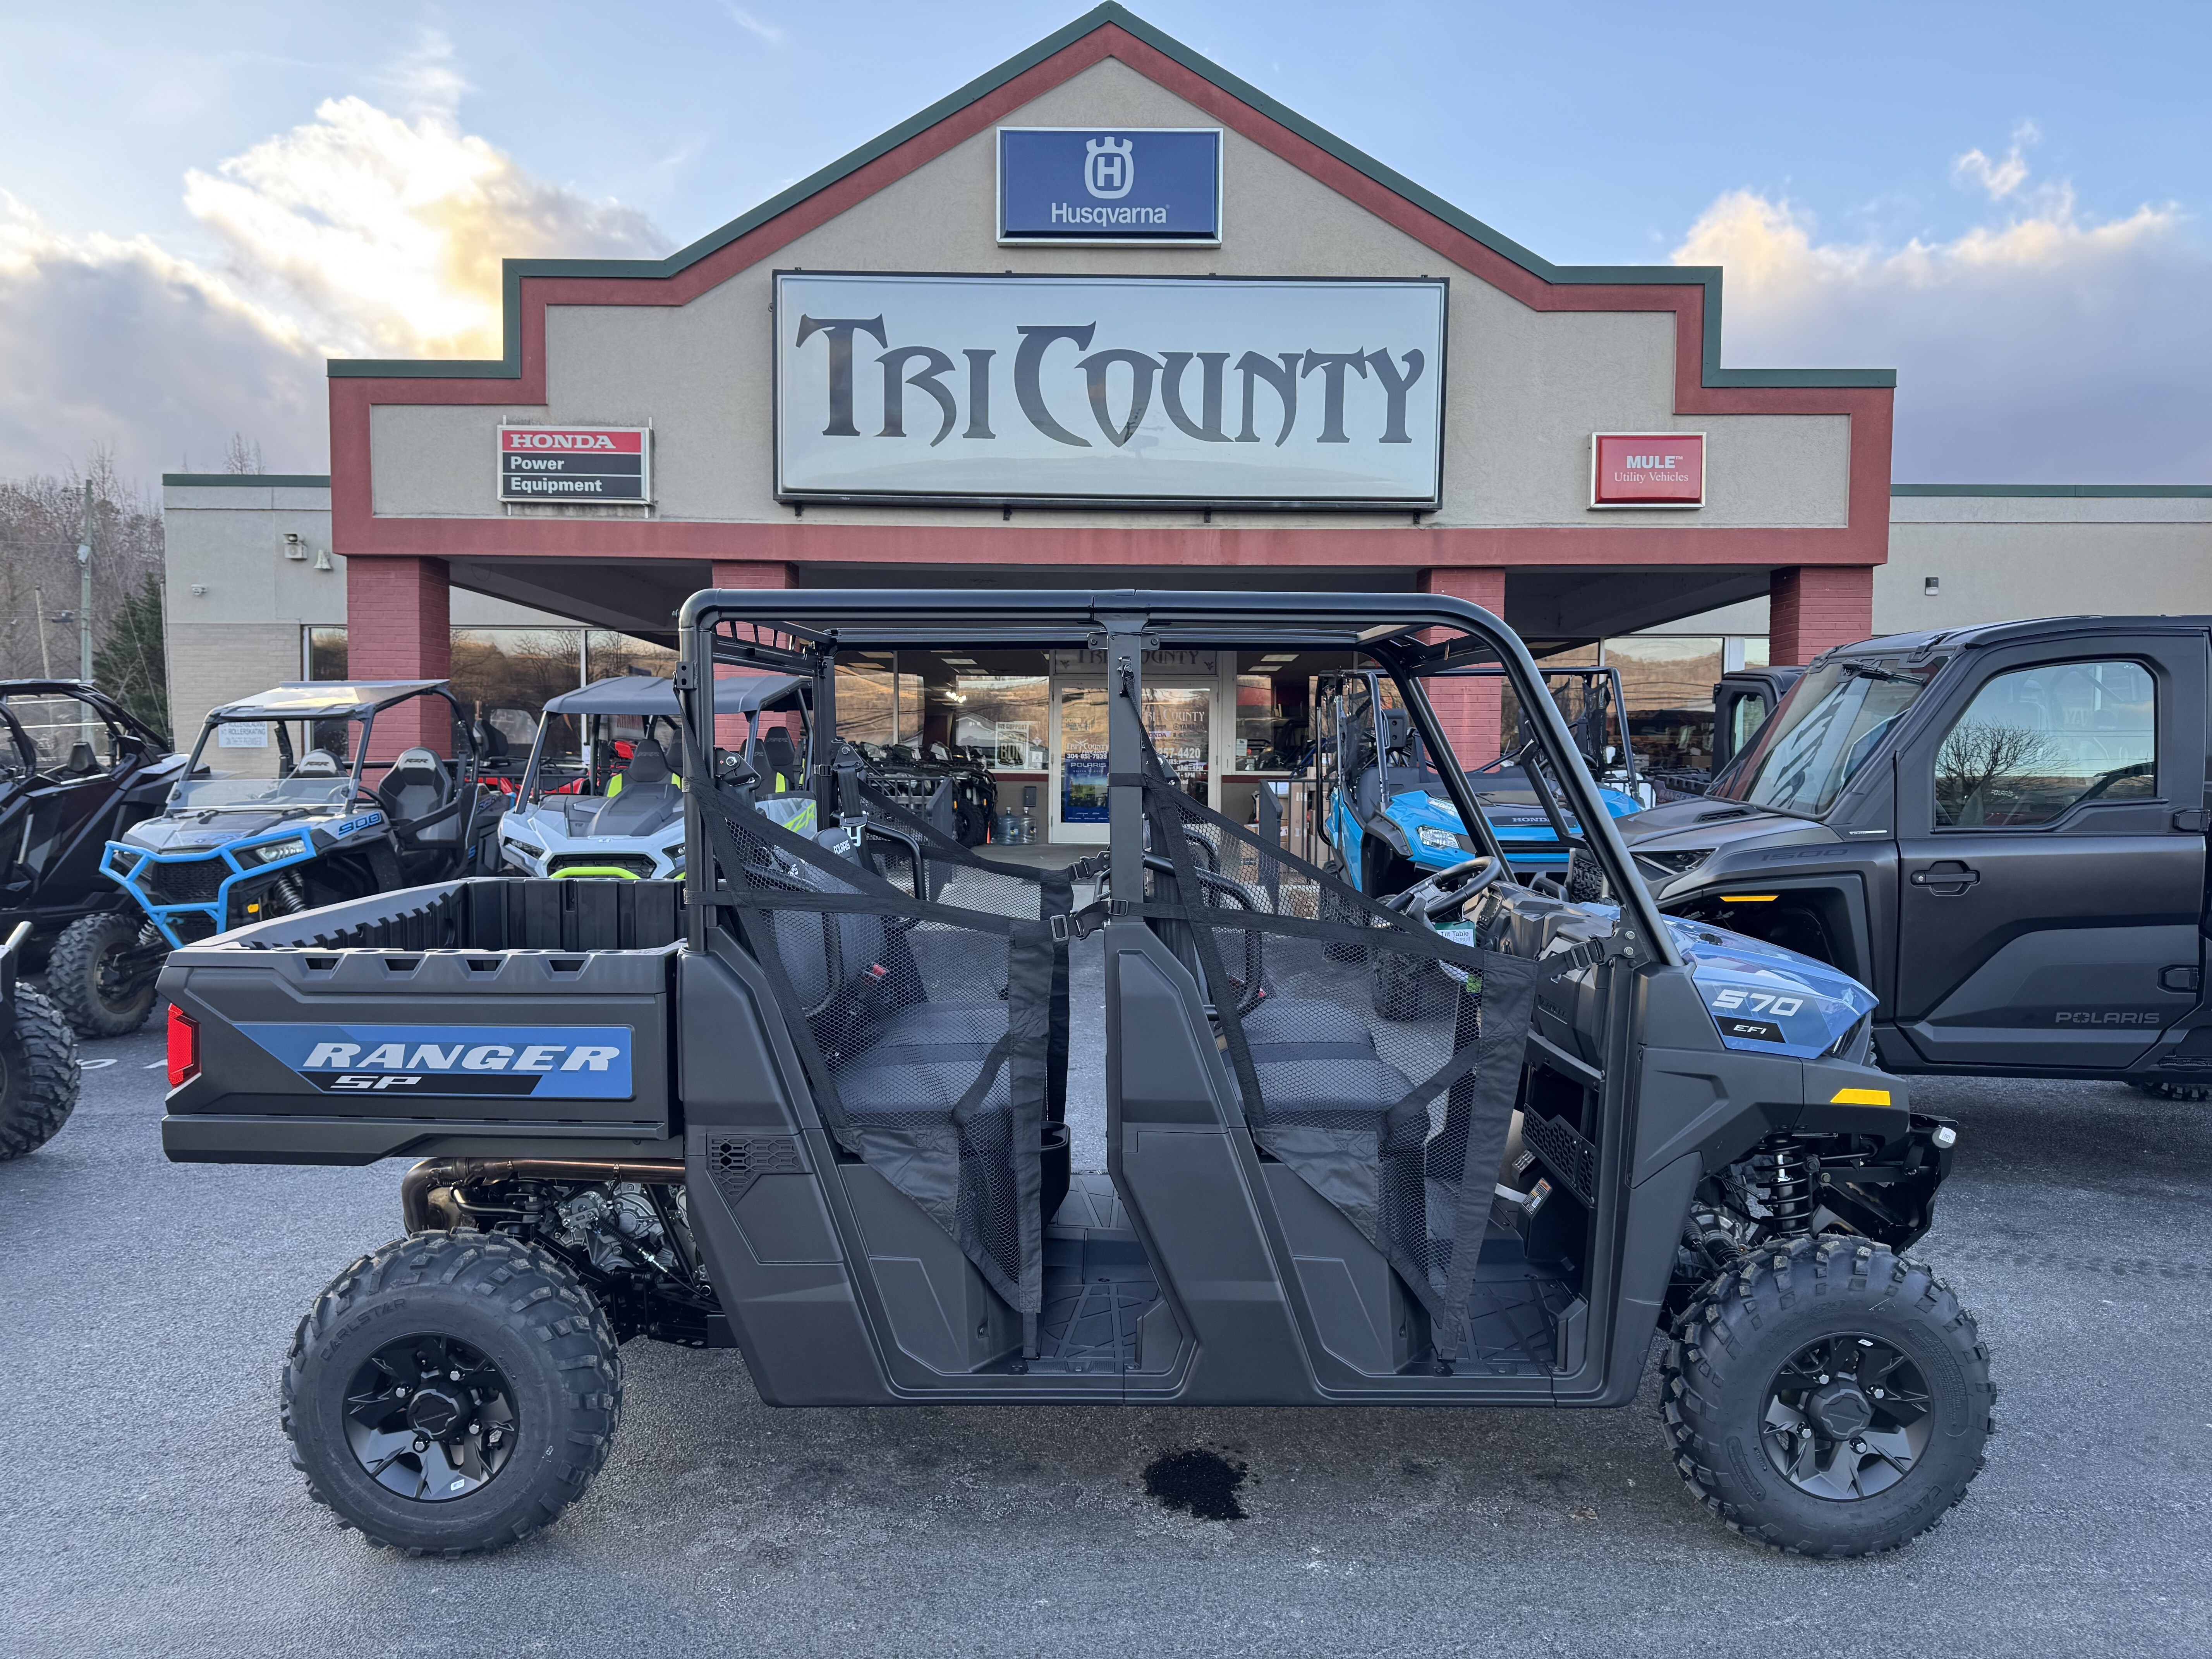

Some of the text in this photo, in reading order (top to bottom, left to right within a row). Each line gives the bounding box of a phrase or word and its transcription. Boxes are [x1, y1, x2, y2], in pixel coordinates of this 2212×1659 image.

[1051, 203, 1166, 227] Husqvarna
[510, 434, 616, 448] HONDA
[510, 456, 564, 470] Power
[511, 477, 602, 494] Equipment
[1614, 472, 1689, 484] Utility Vehicles
[833, 840, 850, 855] POLARIS
[1760, 849, 1848, 861] 1500
[1712, 989, 1803, 1017] 570
[2055, 1012, 2160, 1024] POLARIS
[1733, 1024, 1767, 1034] EFI
[302, 1042, 620, 1072] RANGER
[330, 1075, 422, 1090] SP
[320, 1298, 405, 1361] CARLSTAR
